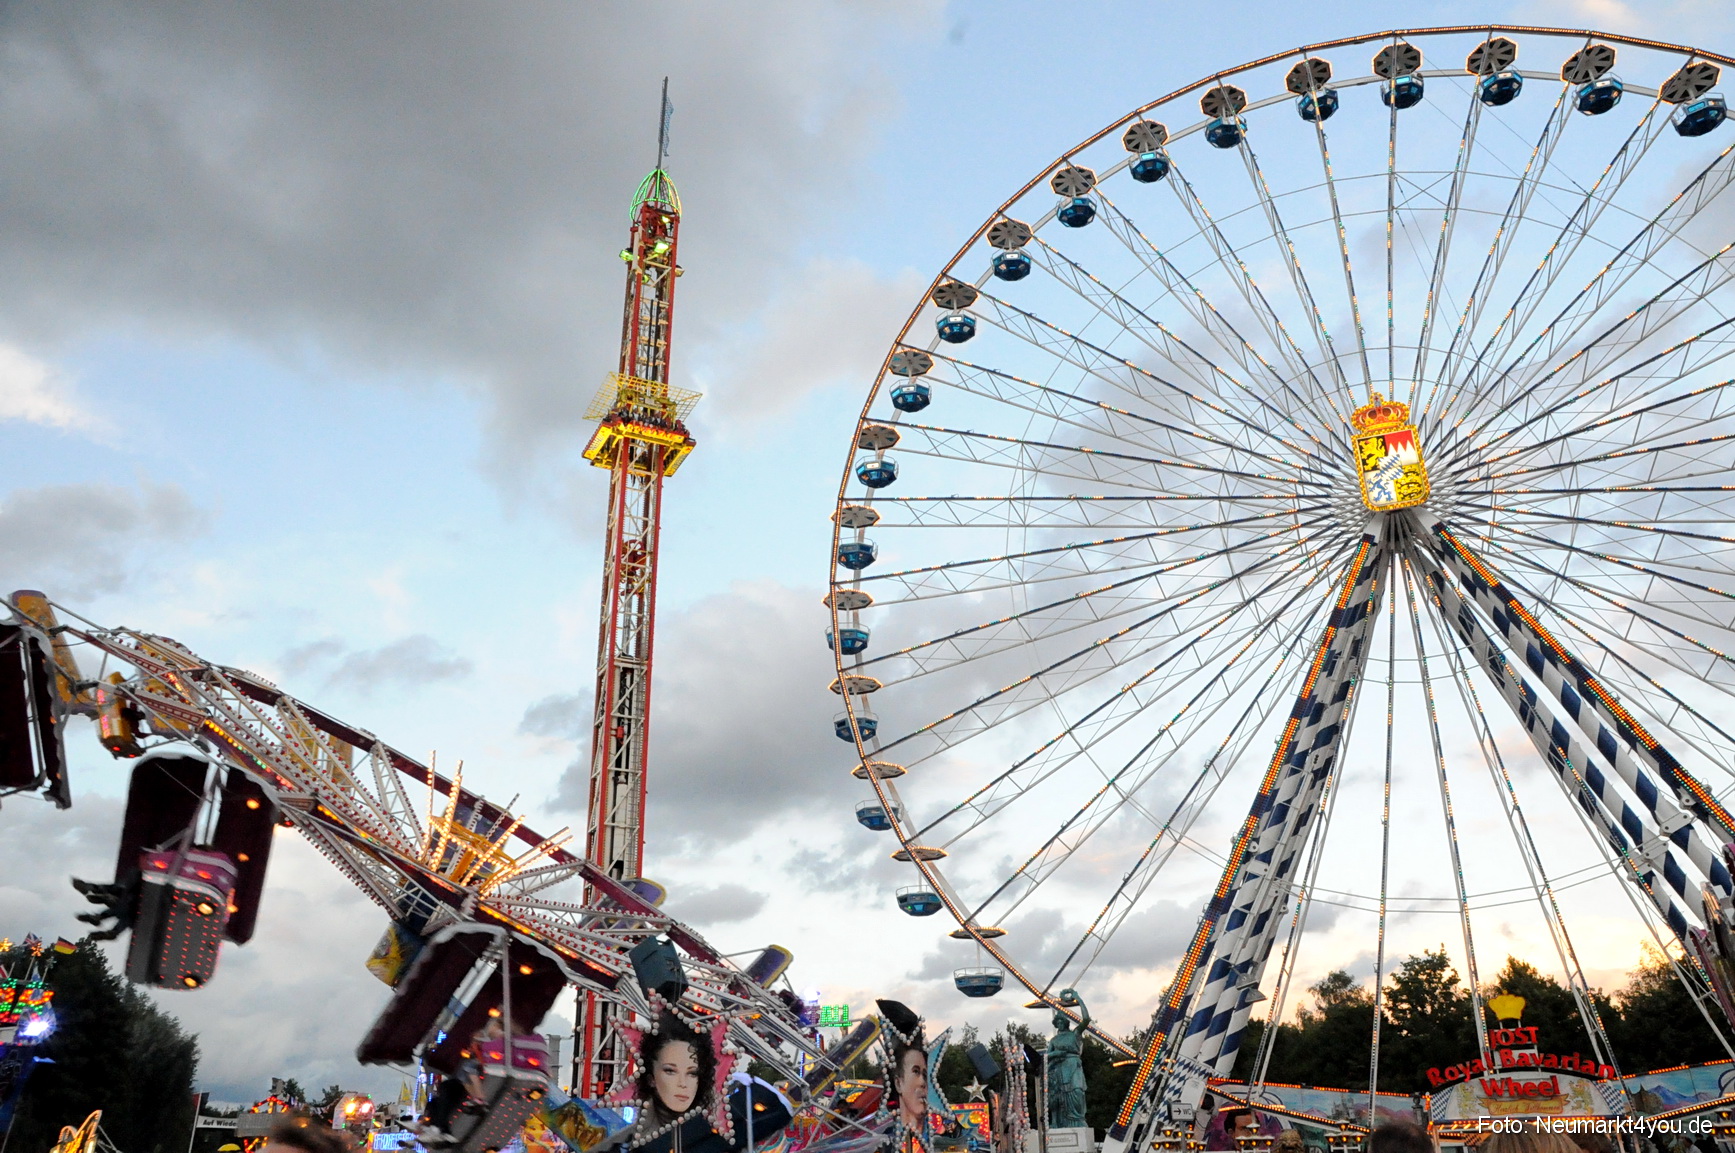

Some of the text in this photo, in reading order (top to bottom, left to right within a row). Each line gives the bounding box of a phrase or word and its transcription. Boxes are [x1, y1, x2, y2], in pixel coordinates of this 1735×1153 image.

[1490, 1026, 1539, 1050] JOST
[1426, 1048, 1615, 1087] Royal Bavarian
[1479, 1075, 1561, 1097] Wheel
